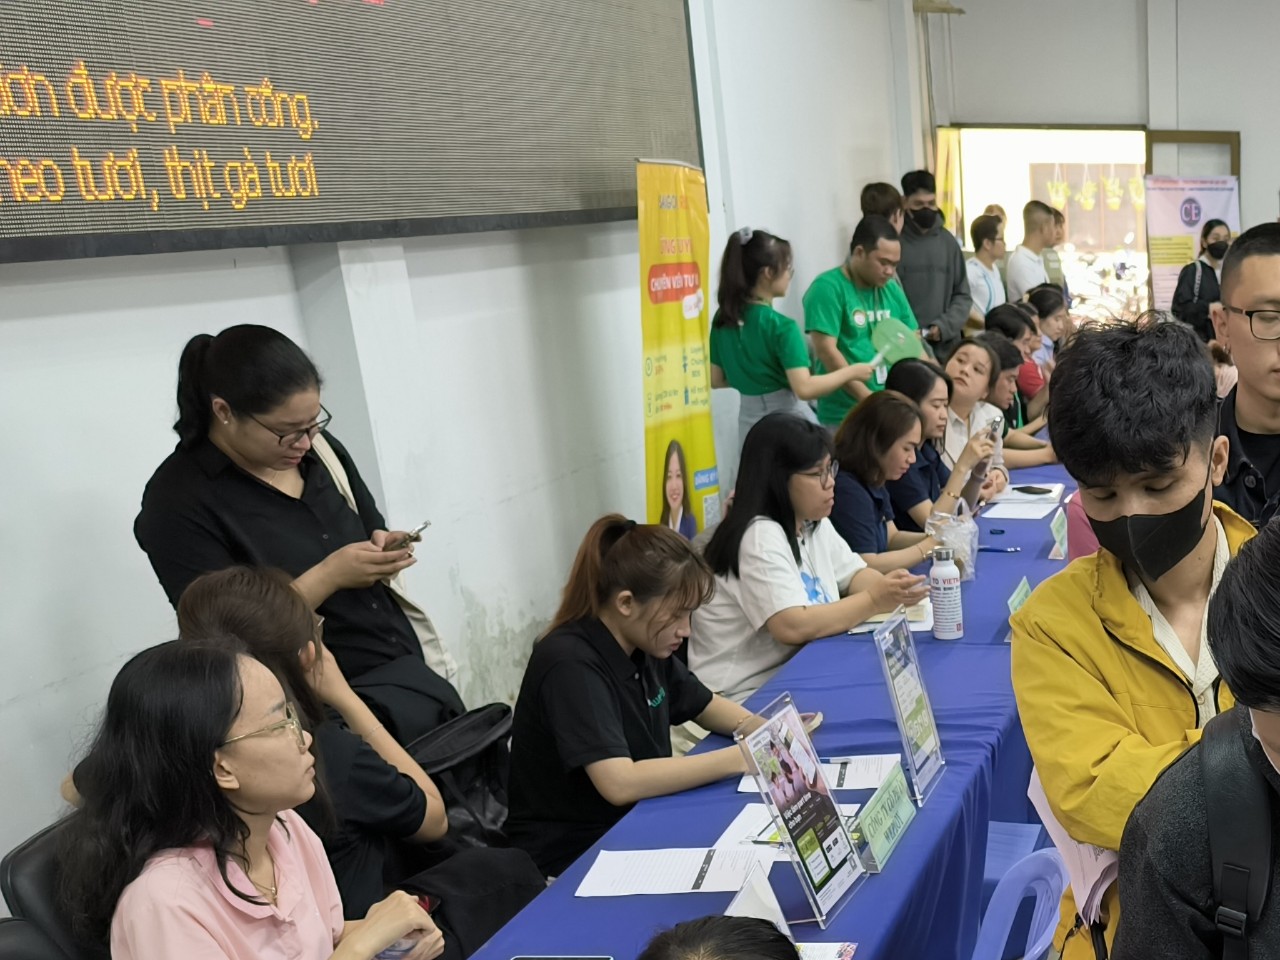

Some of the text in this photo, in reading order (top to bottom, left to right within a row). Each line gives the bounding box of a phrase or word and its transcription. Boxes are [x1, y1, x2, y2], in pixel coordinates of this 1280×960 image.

[67, 60, 156, 133] được
[160, 69, 241, 134] phân
[244, 77, 319, 139] công.
[71, 145, 159, 211] tươi,
[165, 145, 221, 210] thịt
[224, 147, 261, 209] gà
[265, 151, 319, 197] tươi
